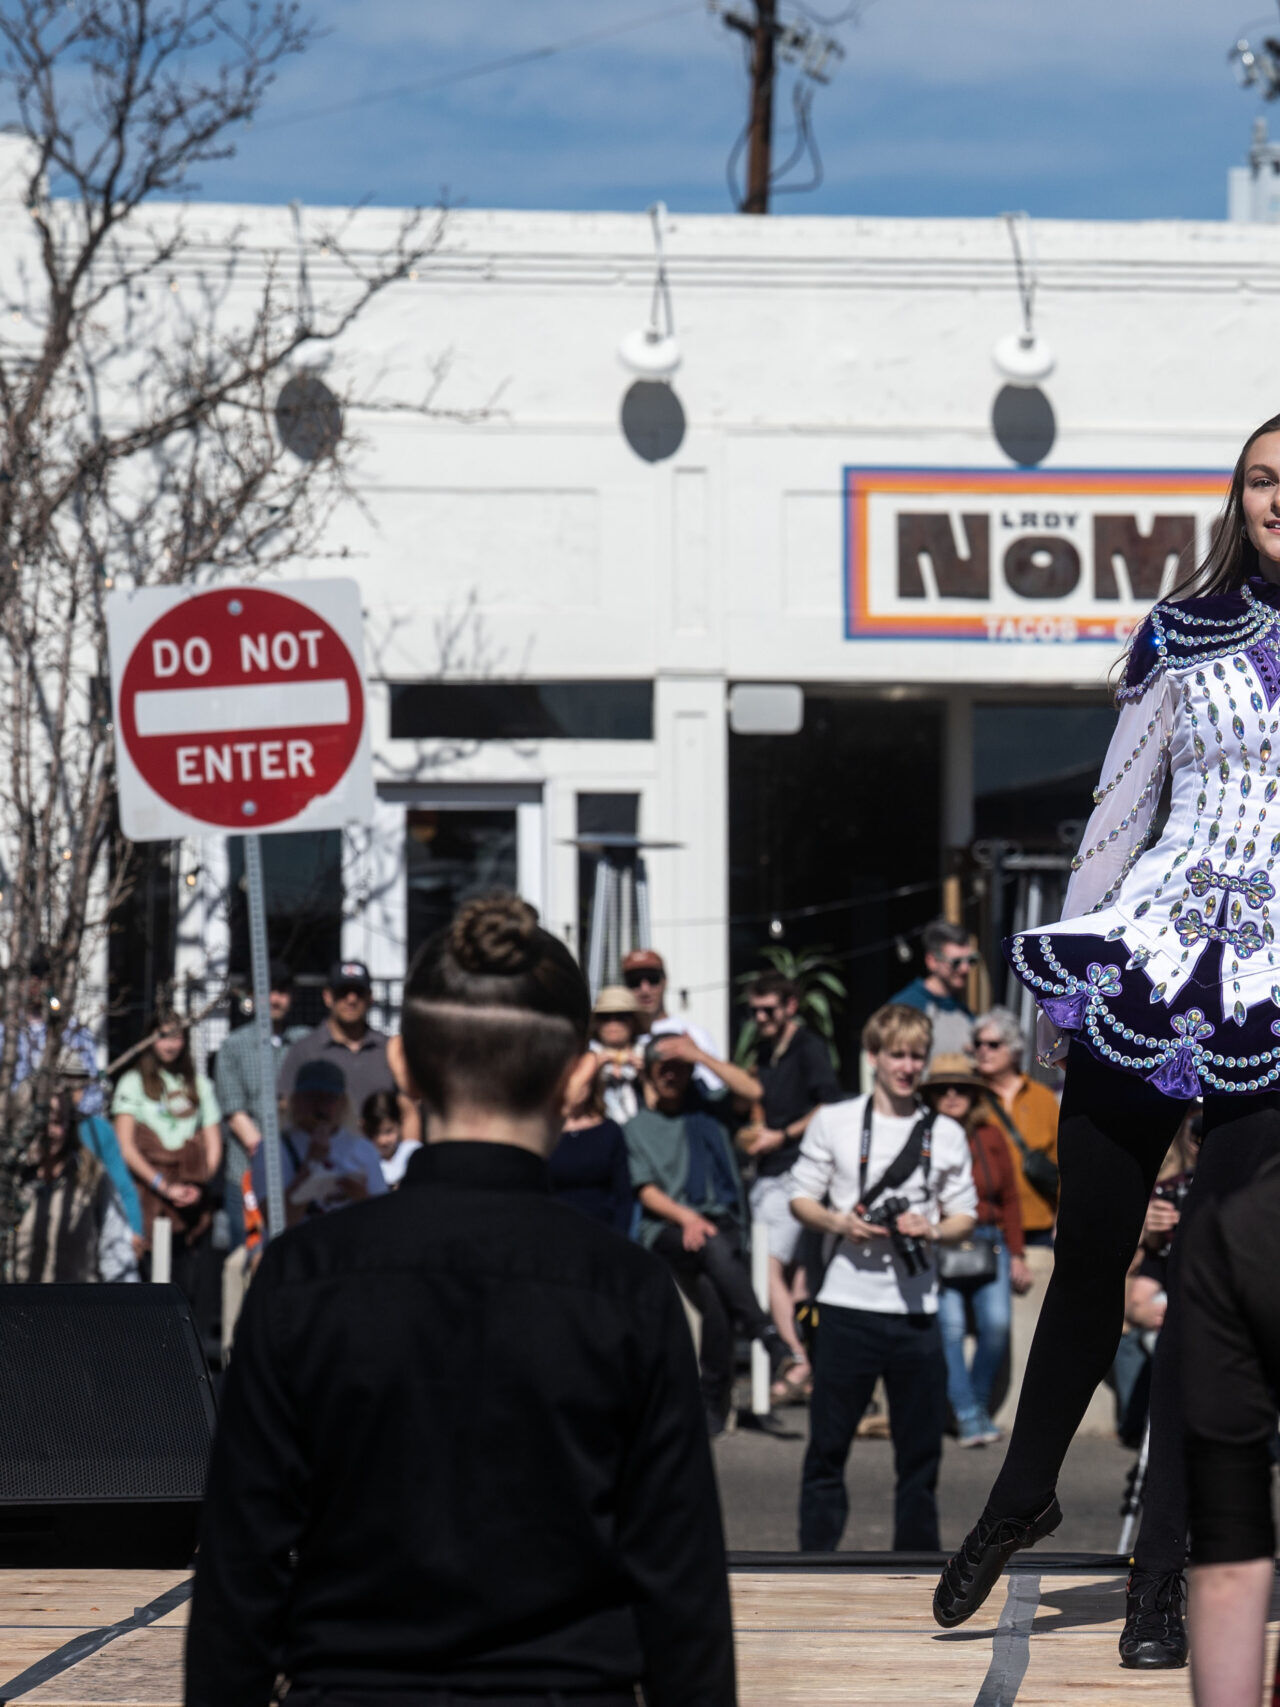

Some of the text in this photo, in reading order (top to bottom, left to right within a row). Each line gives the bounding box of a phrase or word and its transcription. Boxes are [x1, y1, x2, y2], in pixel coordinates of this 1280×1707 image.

[1001, 512, 1079, 528] LADY
[983, 616, 1078, 643] TACOS
[152, 630, 324, 678] DO NOT
[176, 739, 315, 785] ENTER
